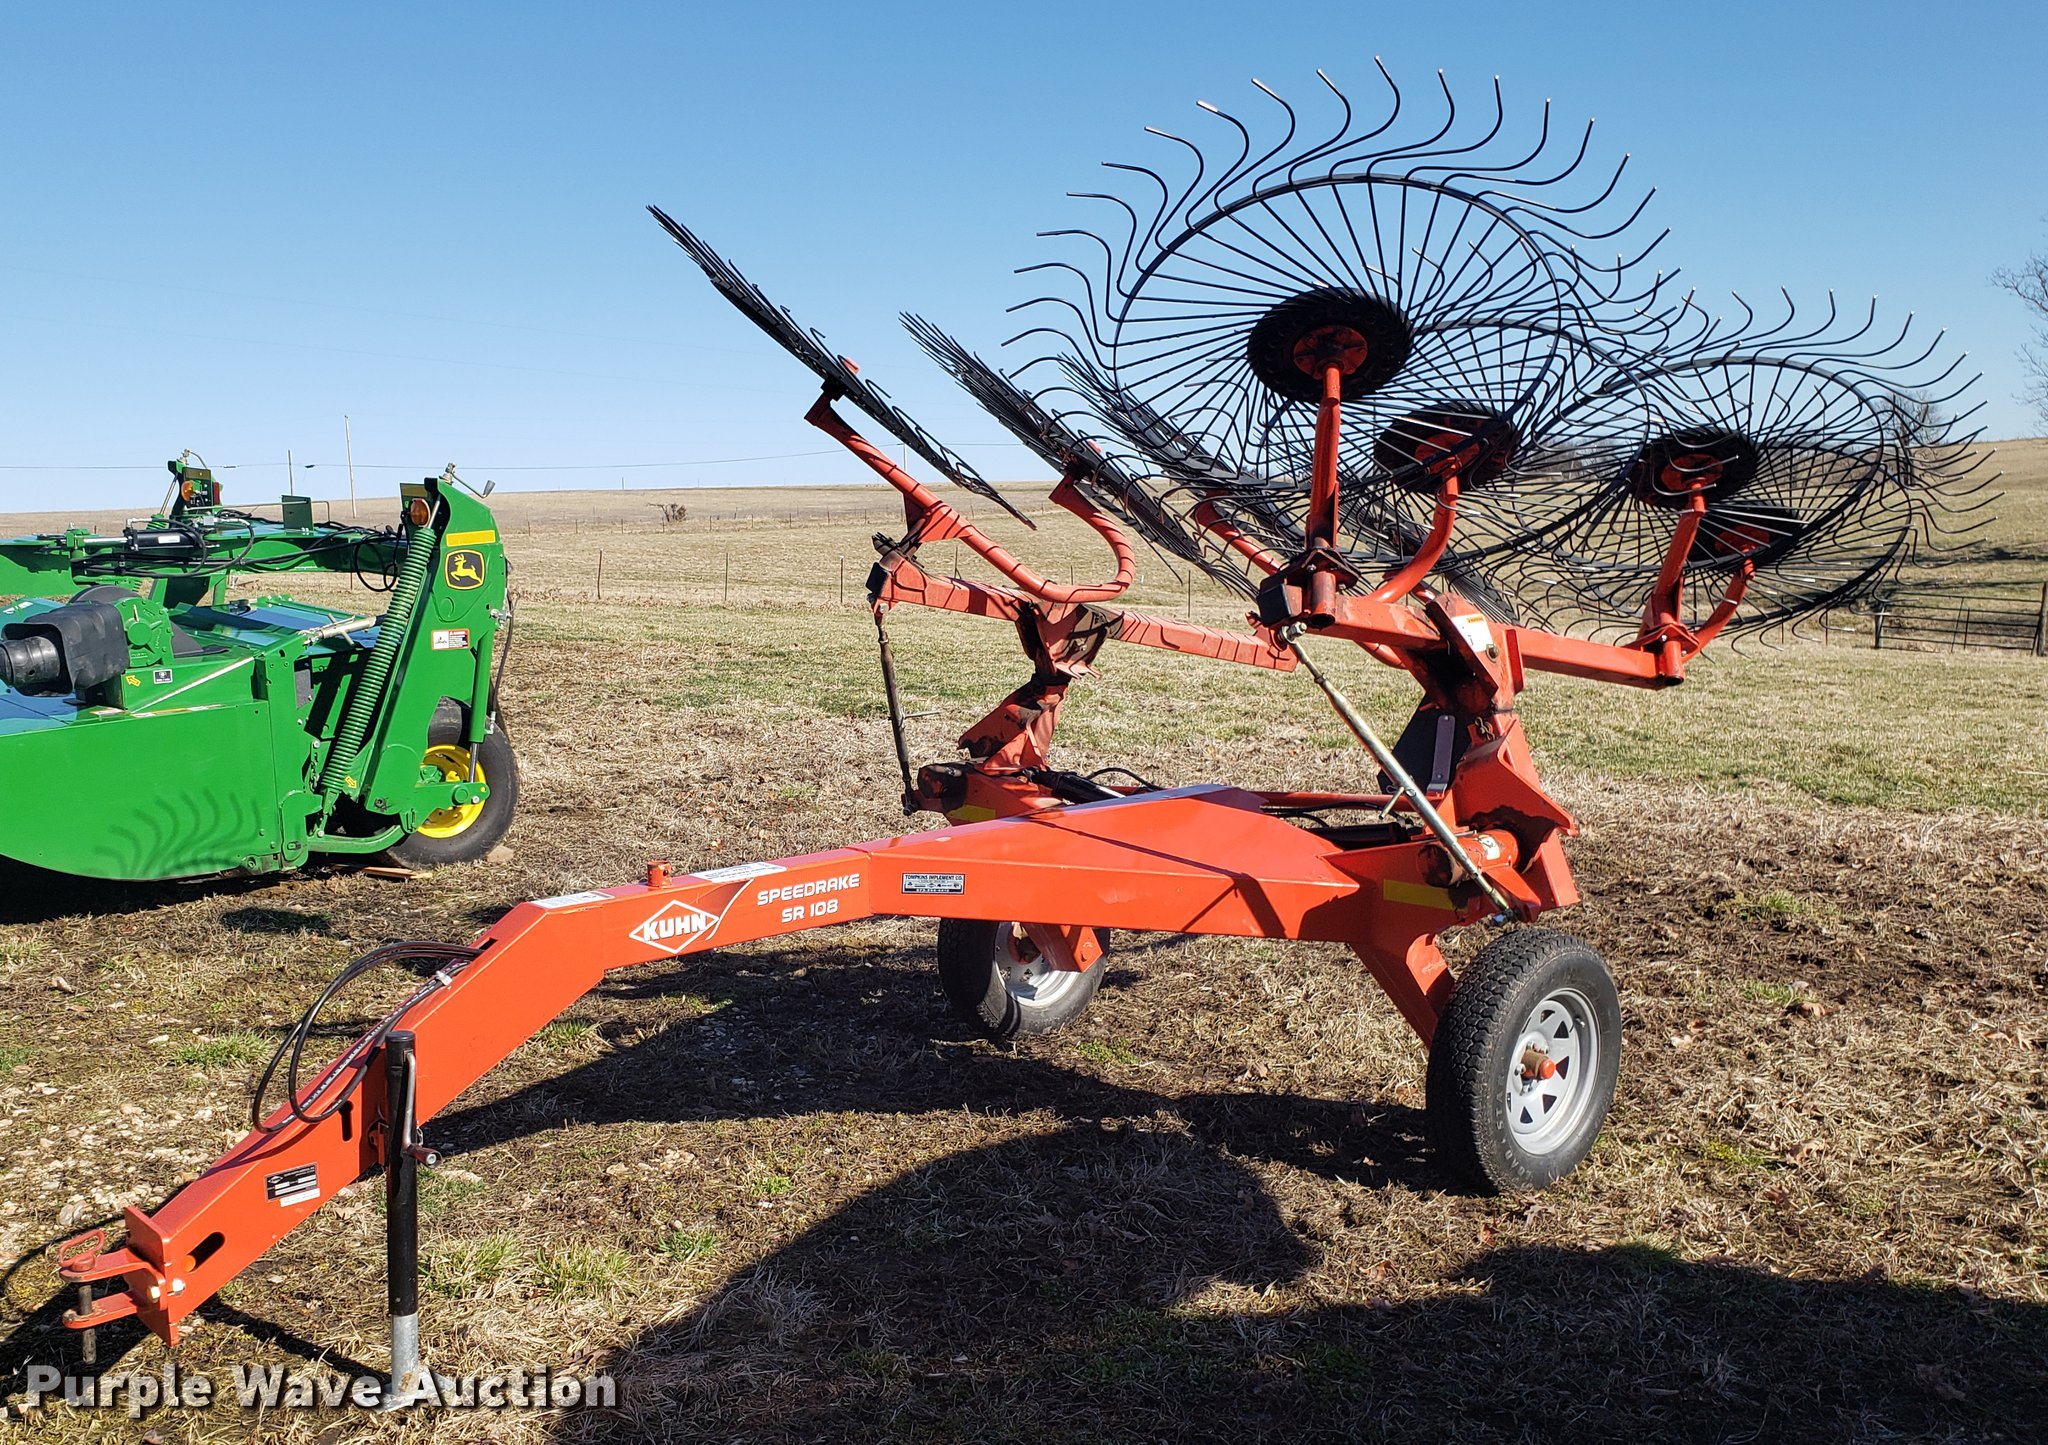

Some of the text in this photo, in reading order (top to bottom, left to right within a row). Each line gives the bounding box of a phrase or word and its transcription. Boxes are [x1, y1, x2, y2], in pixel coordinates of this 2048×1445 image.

[757, 873, 860, 906] SPEEDRAKE
[781, 899, 839, 924] SR 108
[643, 913, 708, 941] KUHN
